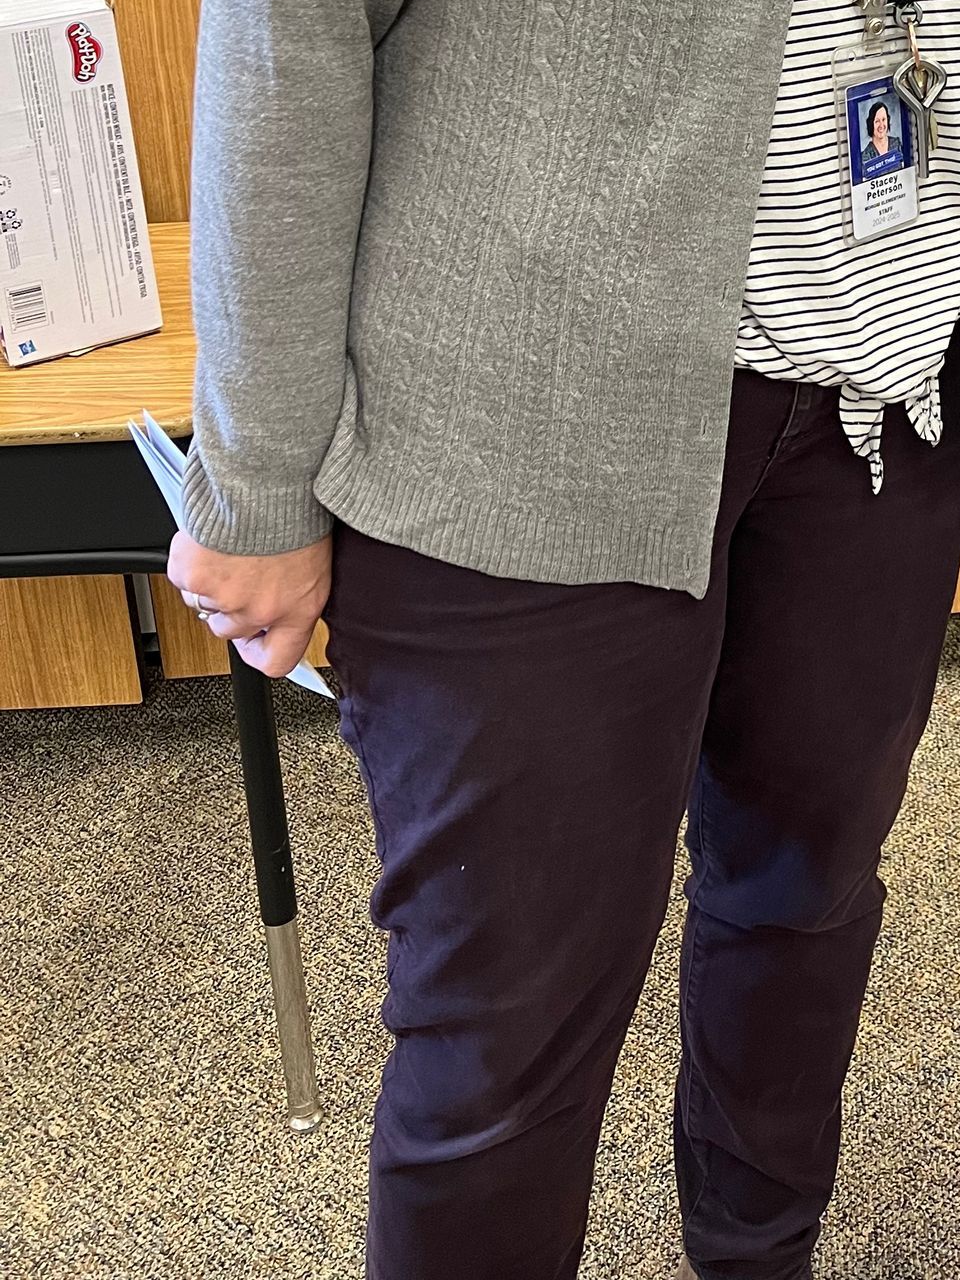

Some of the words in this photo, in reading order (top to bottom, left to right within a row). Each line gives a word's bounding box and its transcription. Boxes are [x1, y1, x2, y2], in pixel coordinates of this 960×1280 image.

[70, 24, 96, 80] Play-Doh
[866, 182, 903, 201] Peterson
[870, 174, 898, 190] Stacey
